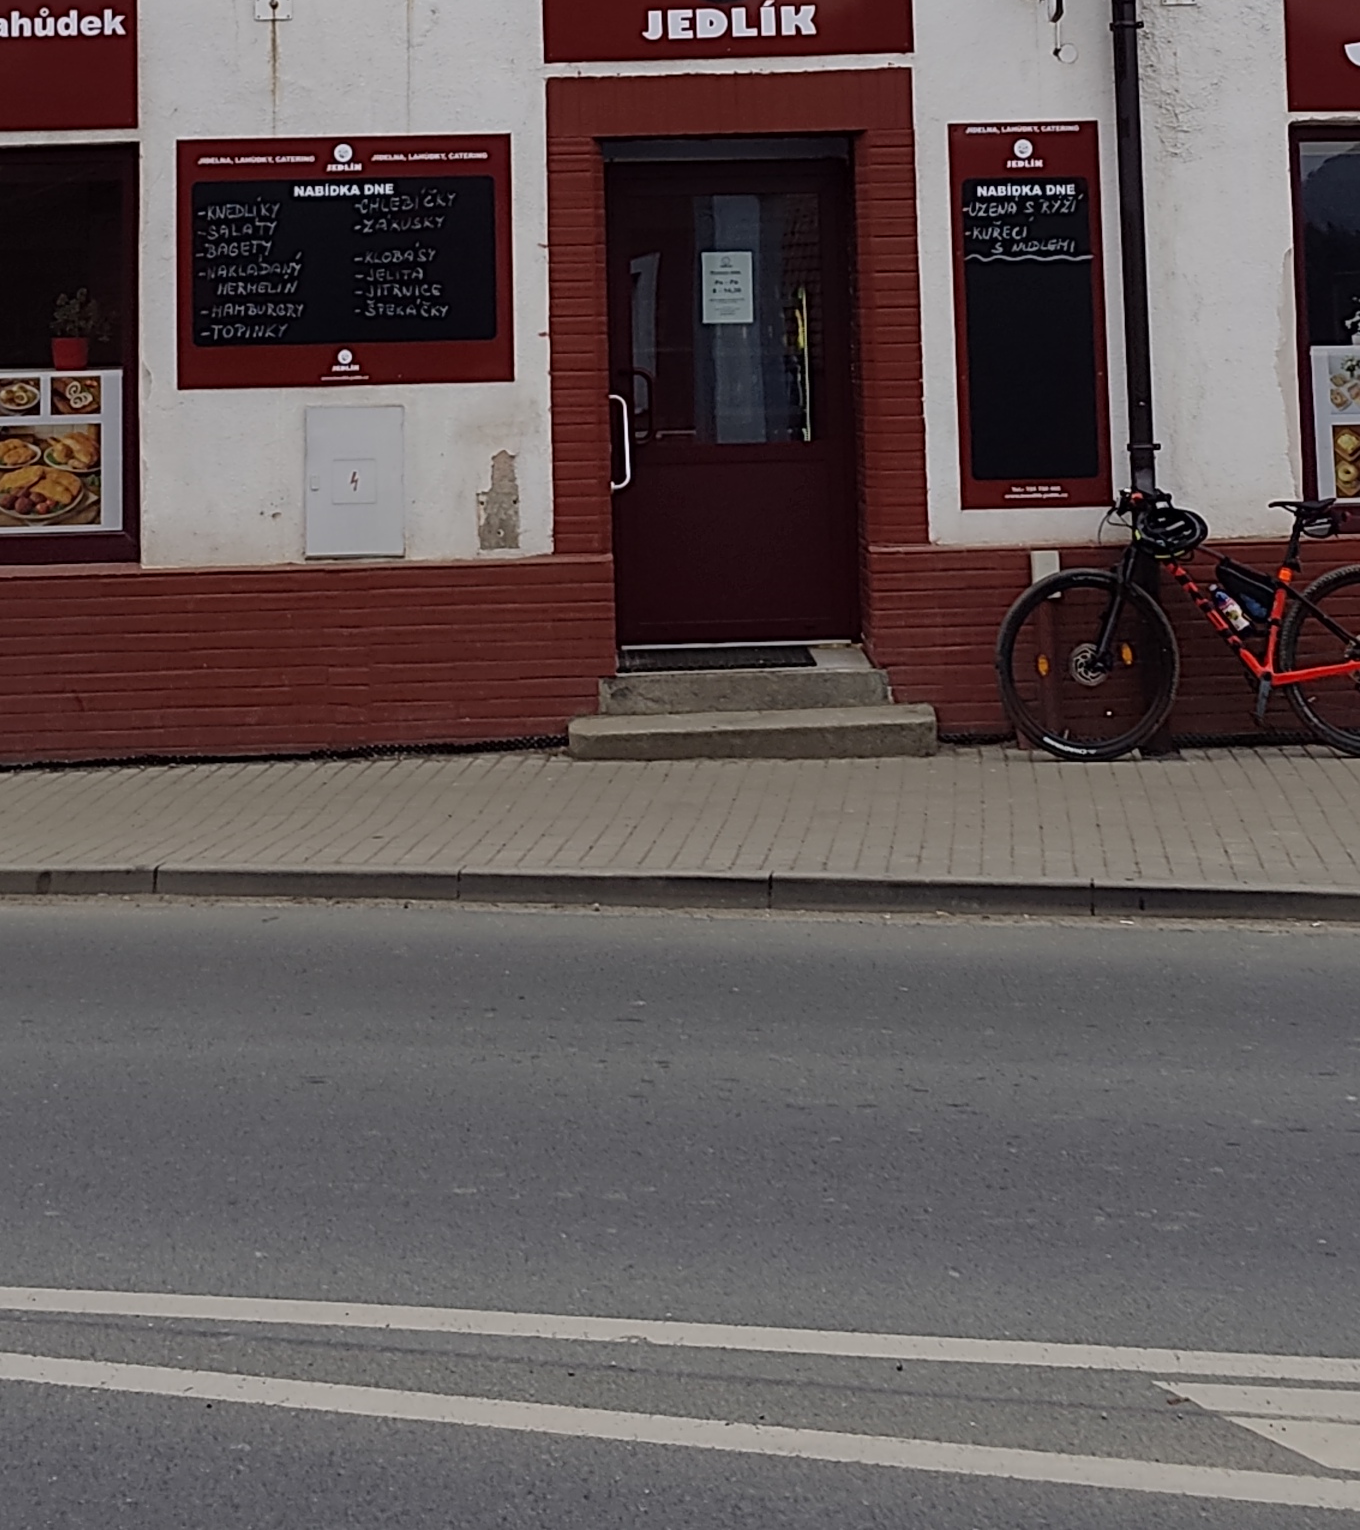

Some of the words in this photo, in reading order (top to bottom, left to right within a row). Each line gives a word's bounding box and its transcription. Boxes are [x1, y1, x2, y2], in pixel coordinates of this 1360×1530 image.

[642, 0, 817, 40] JEDLÍK
[293, 183, 360, 197] NABÍDKA
[364, 183, 394, 196] DNE
[977, 183, 1042, 197] NABÍDKA
[1046, 183, 1076, 196] DNE
